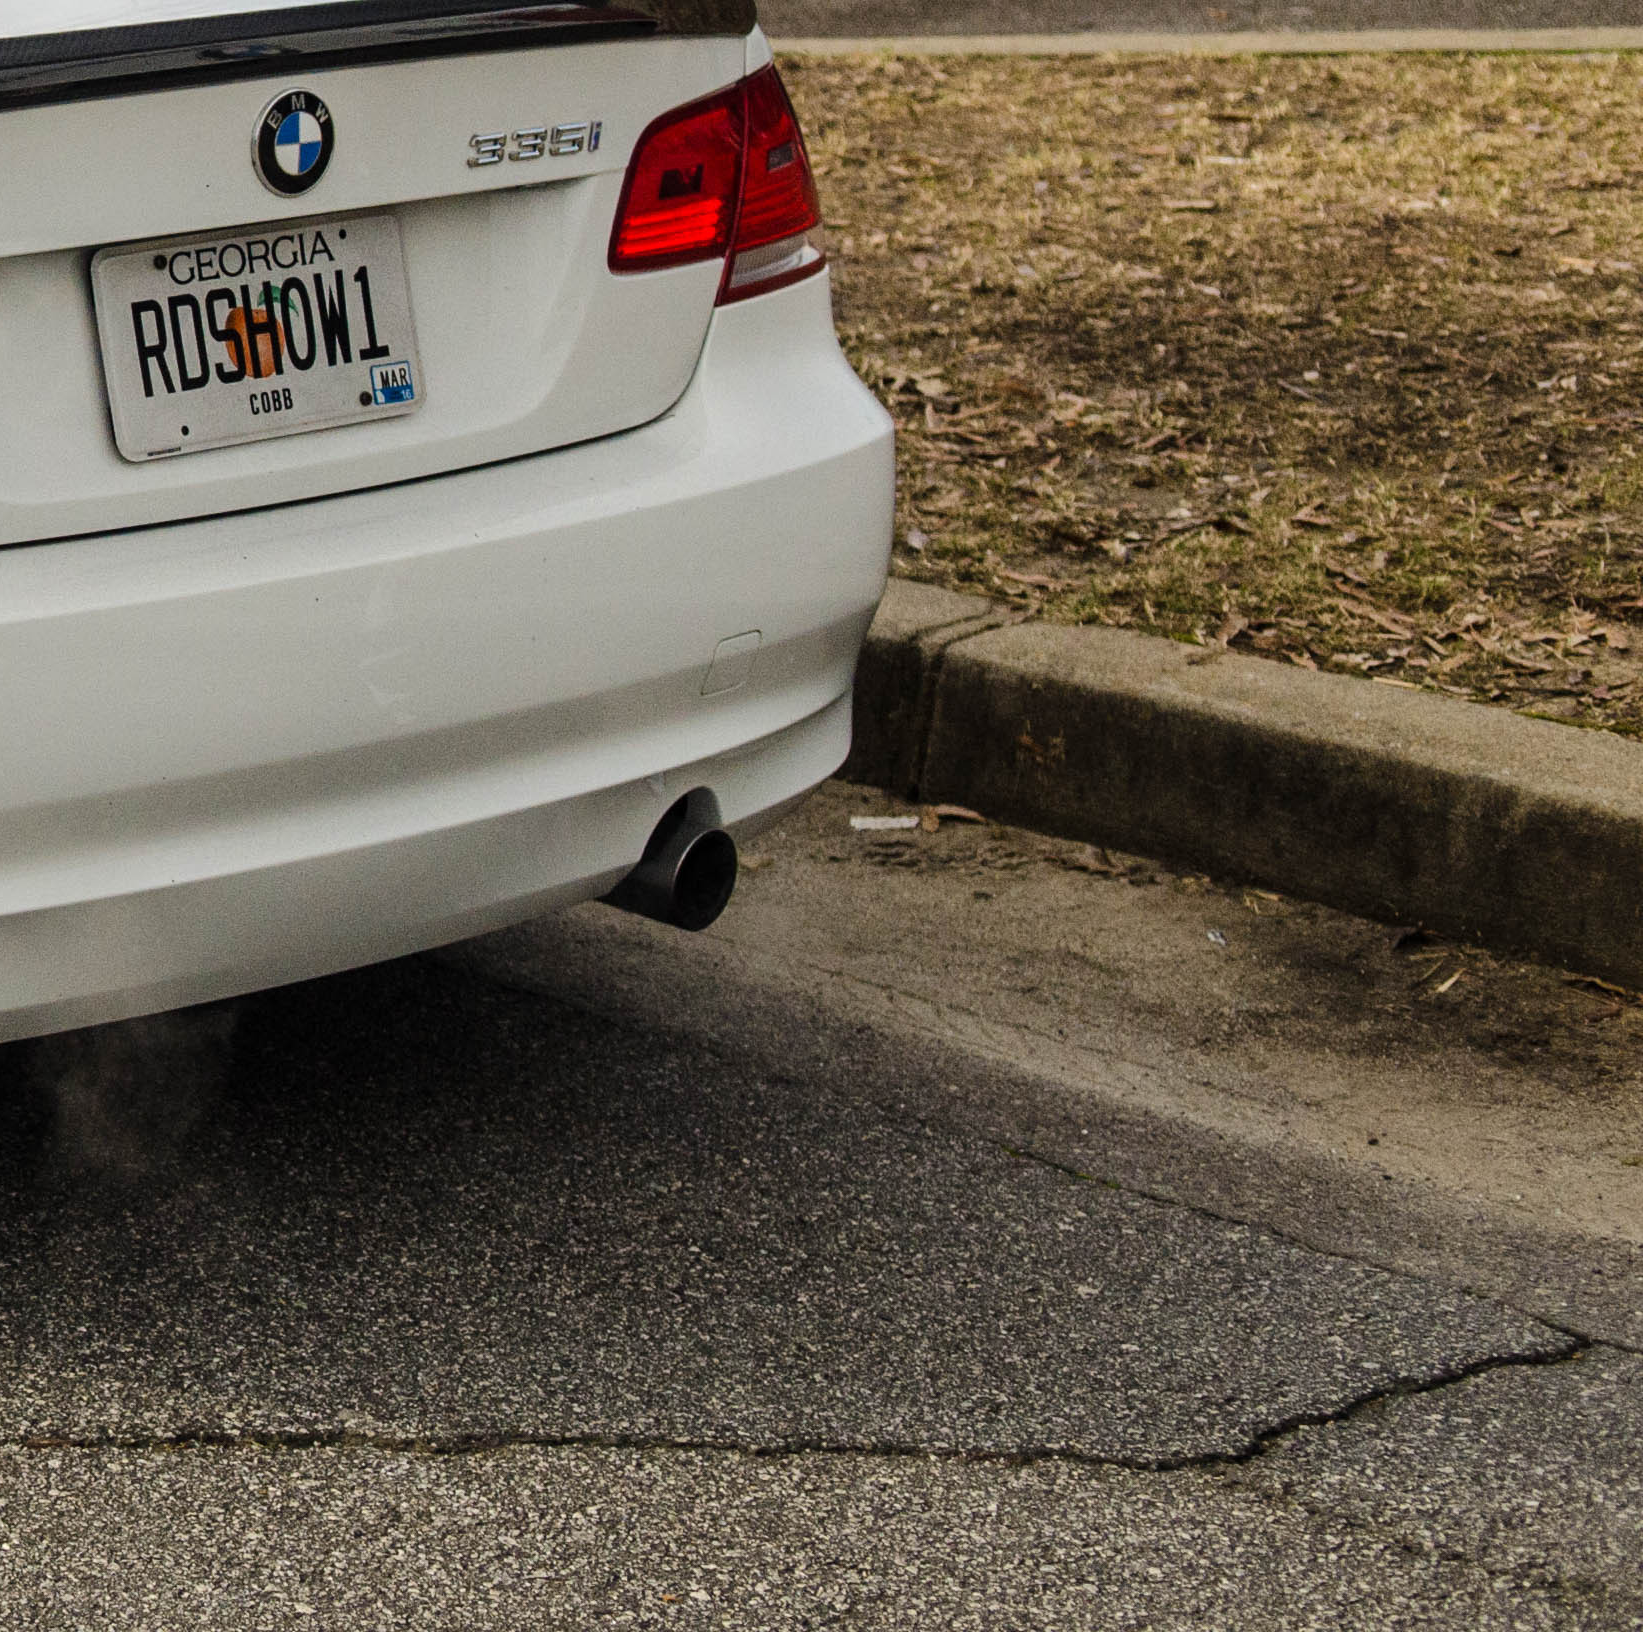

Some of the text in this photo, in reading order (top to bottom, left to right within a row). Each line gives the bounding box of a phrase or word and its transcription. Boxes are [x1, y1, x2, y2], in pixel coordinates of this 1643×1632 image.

[467, 120, 603, 169] 335i
[168, 230, 335, 285] GEORGIA
[130, 266, 390, 398] RDSHOW1
[249, 388, 294, 415] COBB
[380, 367, 409, 388] MAR
